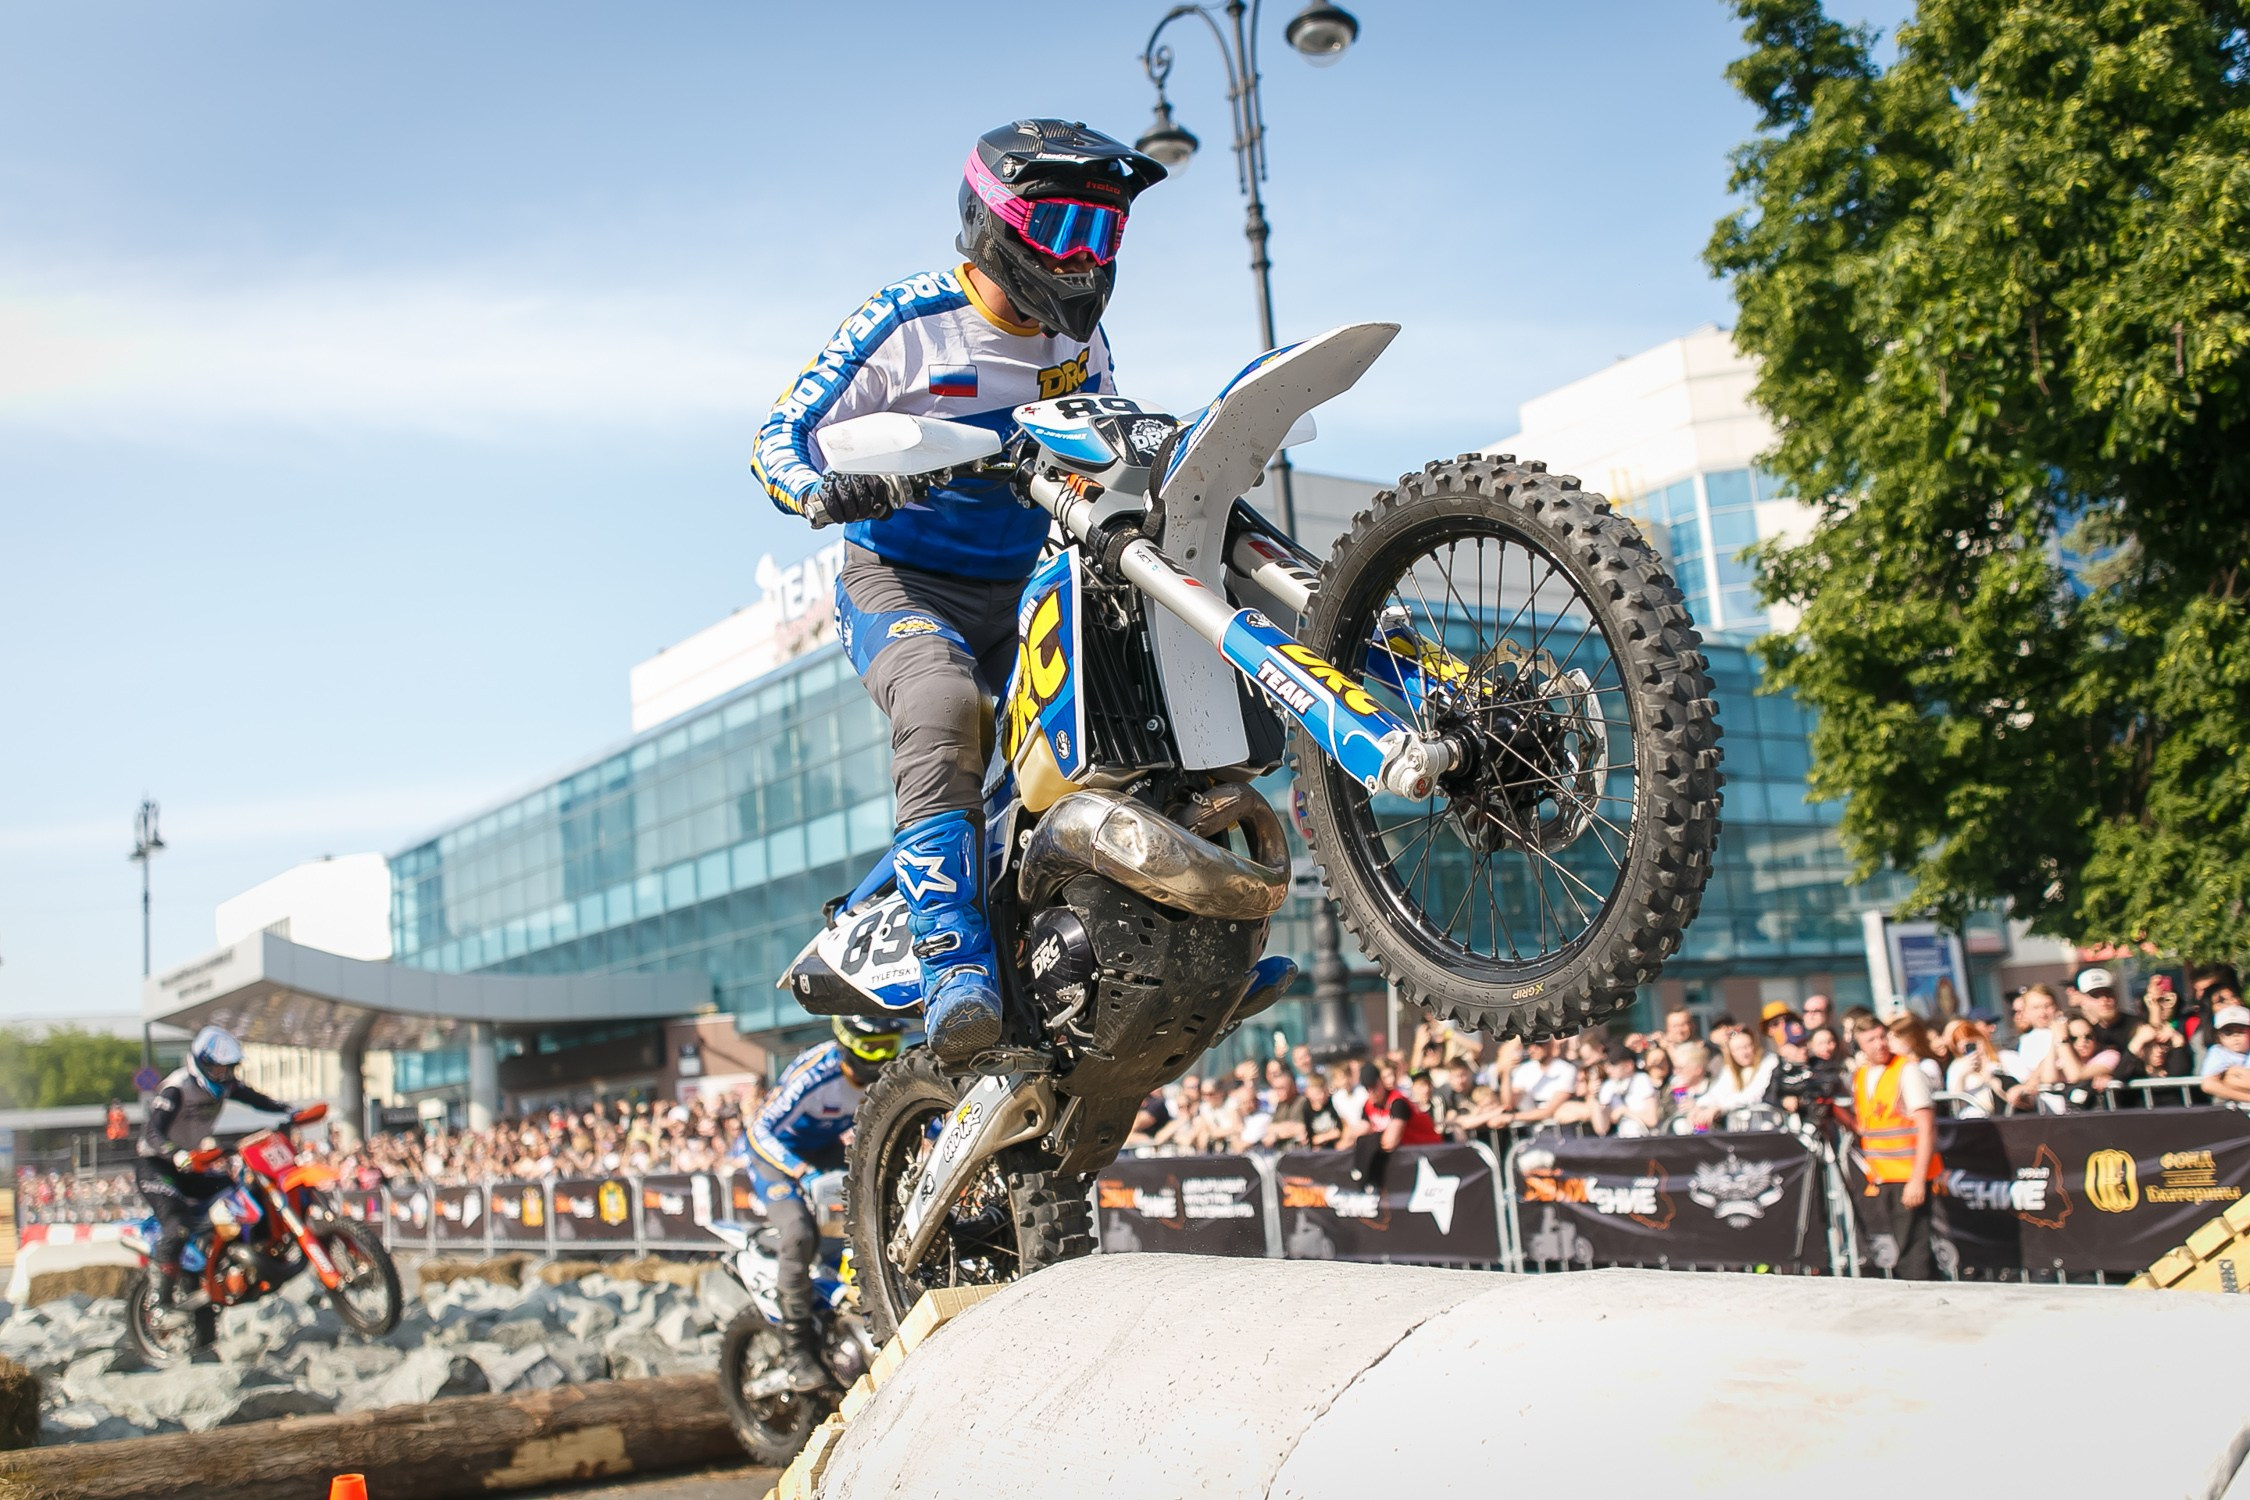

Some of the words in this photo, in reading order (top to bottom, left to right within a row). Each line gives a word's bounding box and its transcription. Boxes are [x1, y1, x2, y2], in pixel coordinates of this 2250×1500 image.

[812, 300, 895, 382] TEAM
[1039, 348, 1090, 399] DRC
[1055, 397, 1143, 419] 89
[1257, 660, 1317, 715] TEAM
[841, 903, 914, 976] 89
[1032, 934, 1060, 979] DRC
[872, 966, 919, 983] TYLETSKY
[943, 1102, 983, 1163] ENDURO
